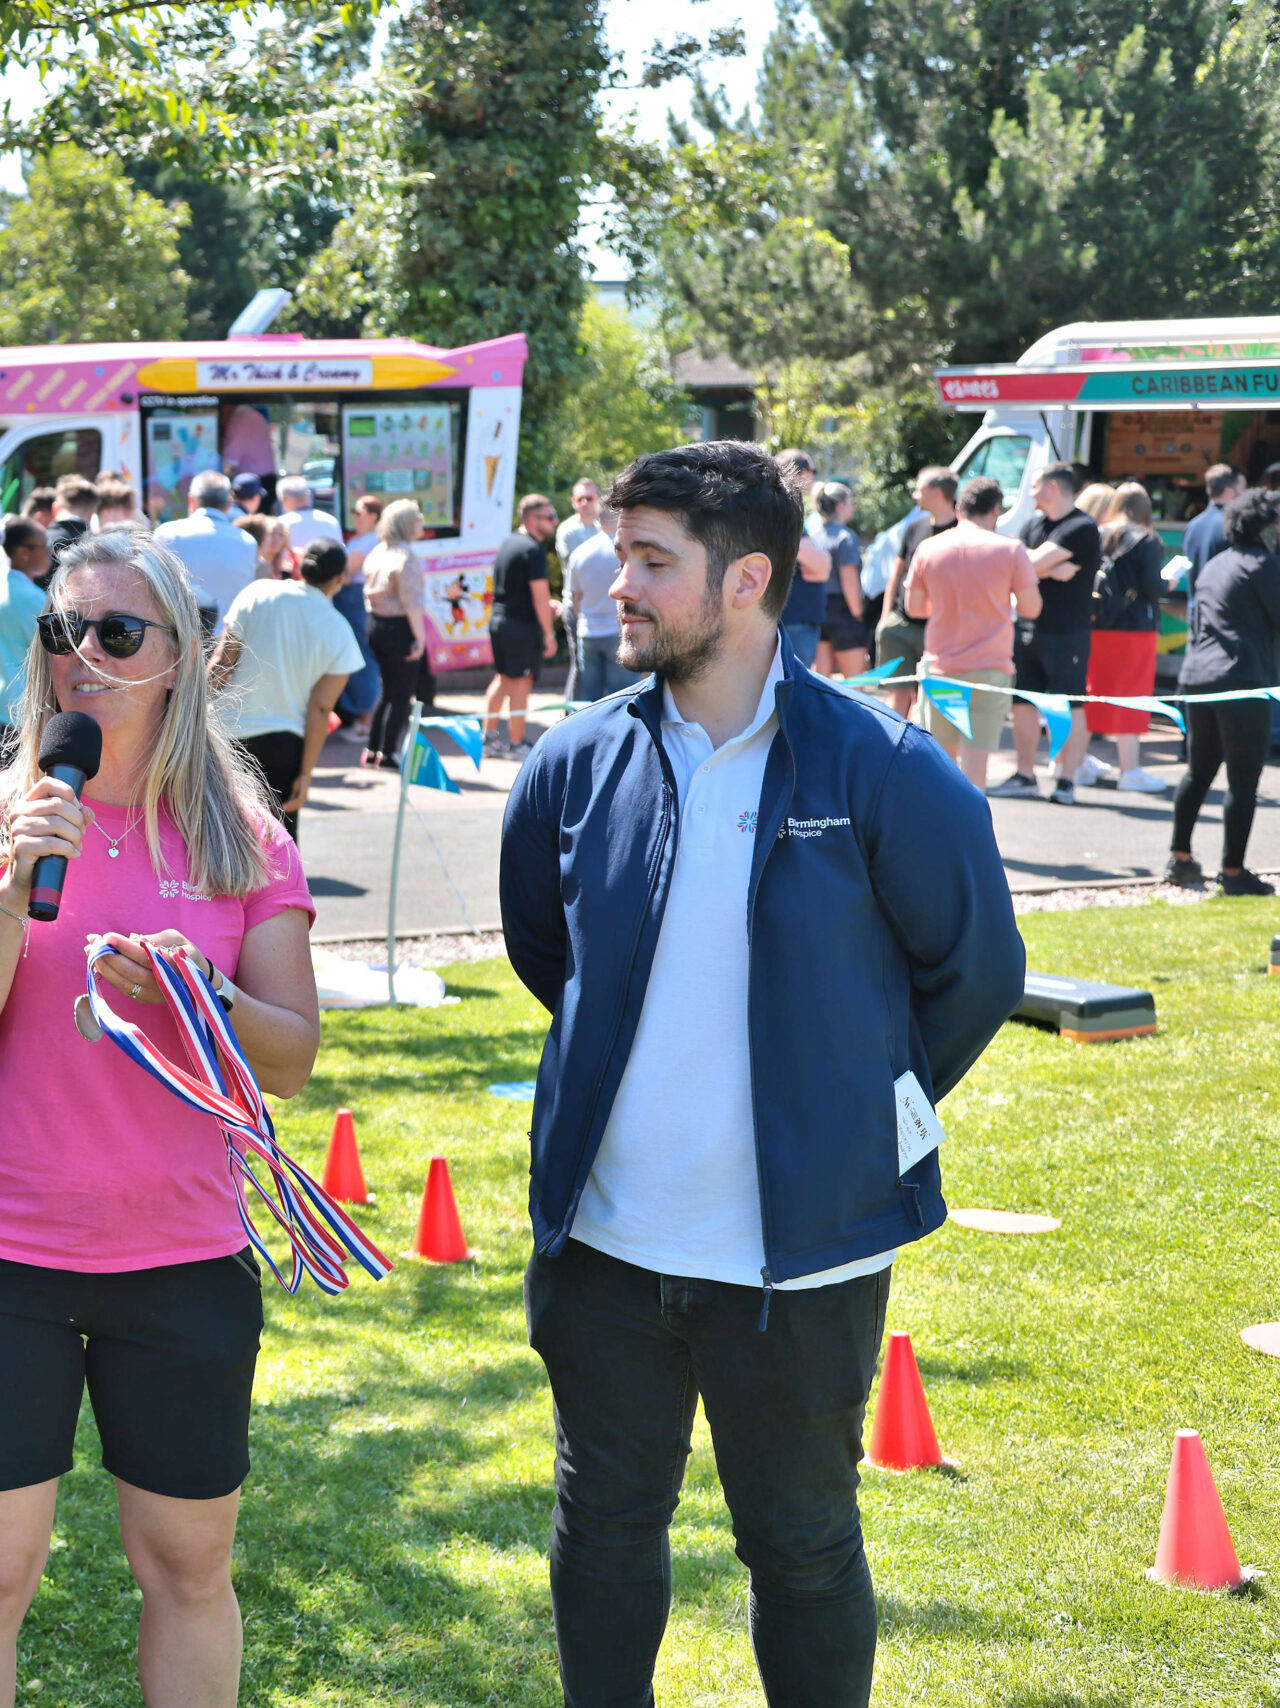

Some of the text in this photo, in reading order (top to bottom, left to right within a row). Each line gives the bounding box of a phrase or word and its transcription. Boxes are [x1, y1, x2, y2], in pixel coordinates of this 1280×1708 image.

[208, 360, 361, 383] Mr Thick & Creamy
[1131, 373, 1249, 396] CARIBBEAN
[788, 817, 850, 829] Birmingham
[789, 828, 822, 839] Hospice
